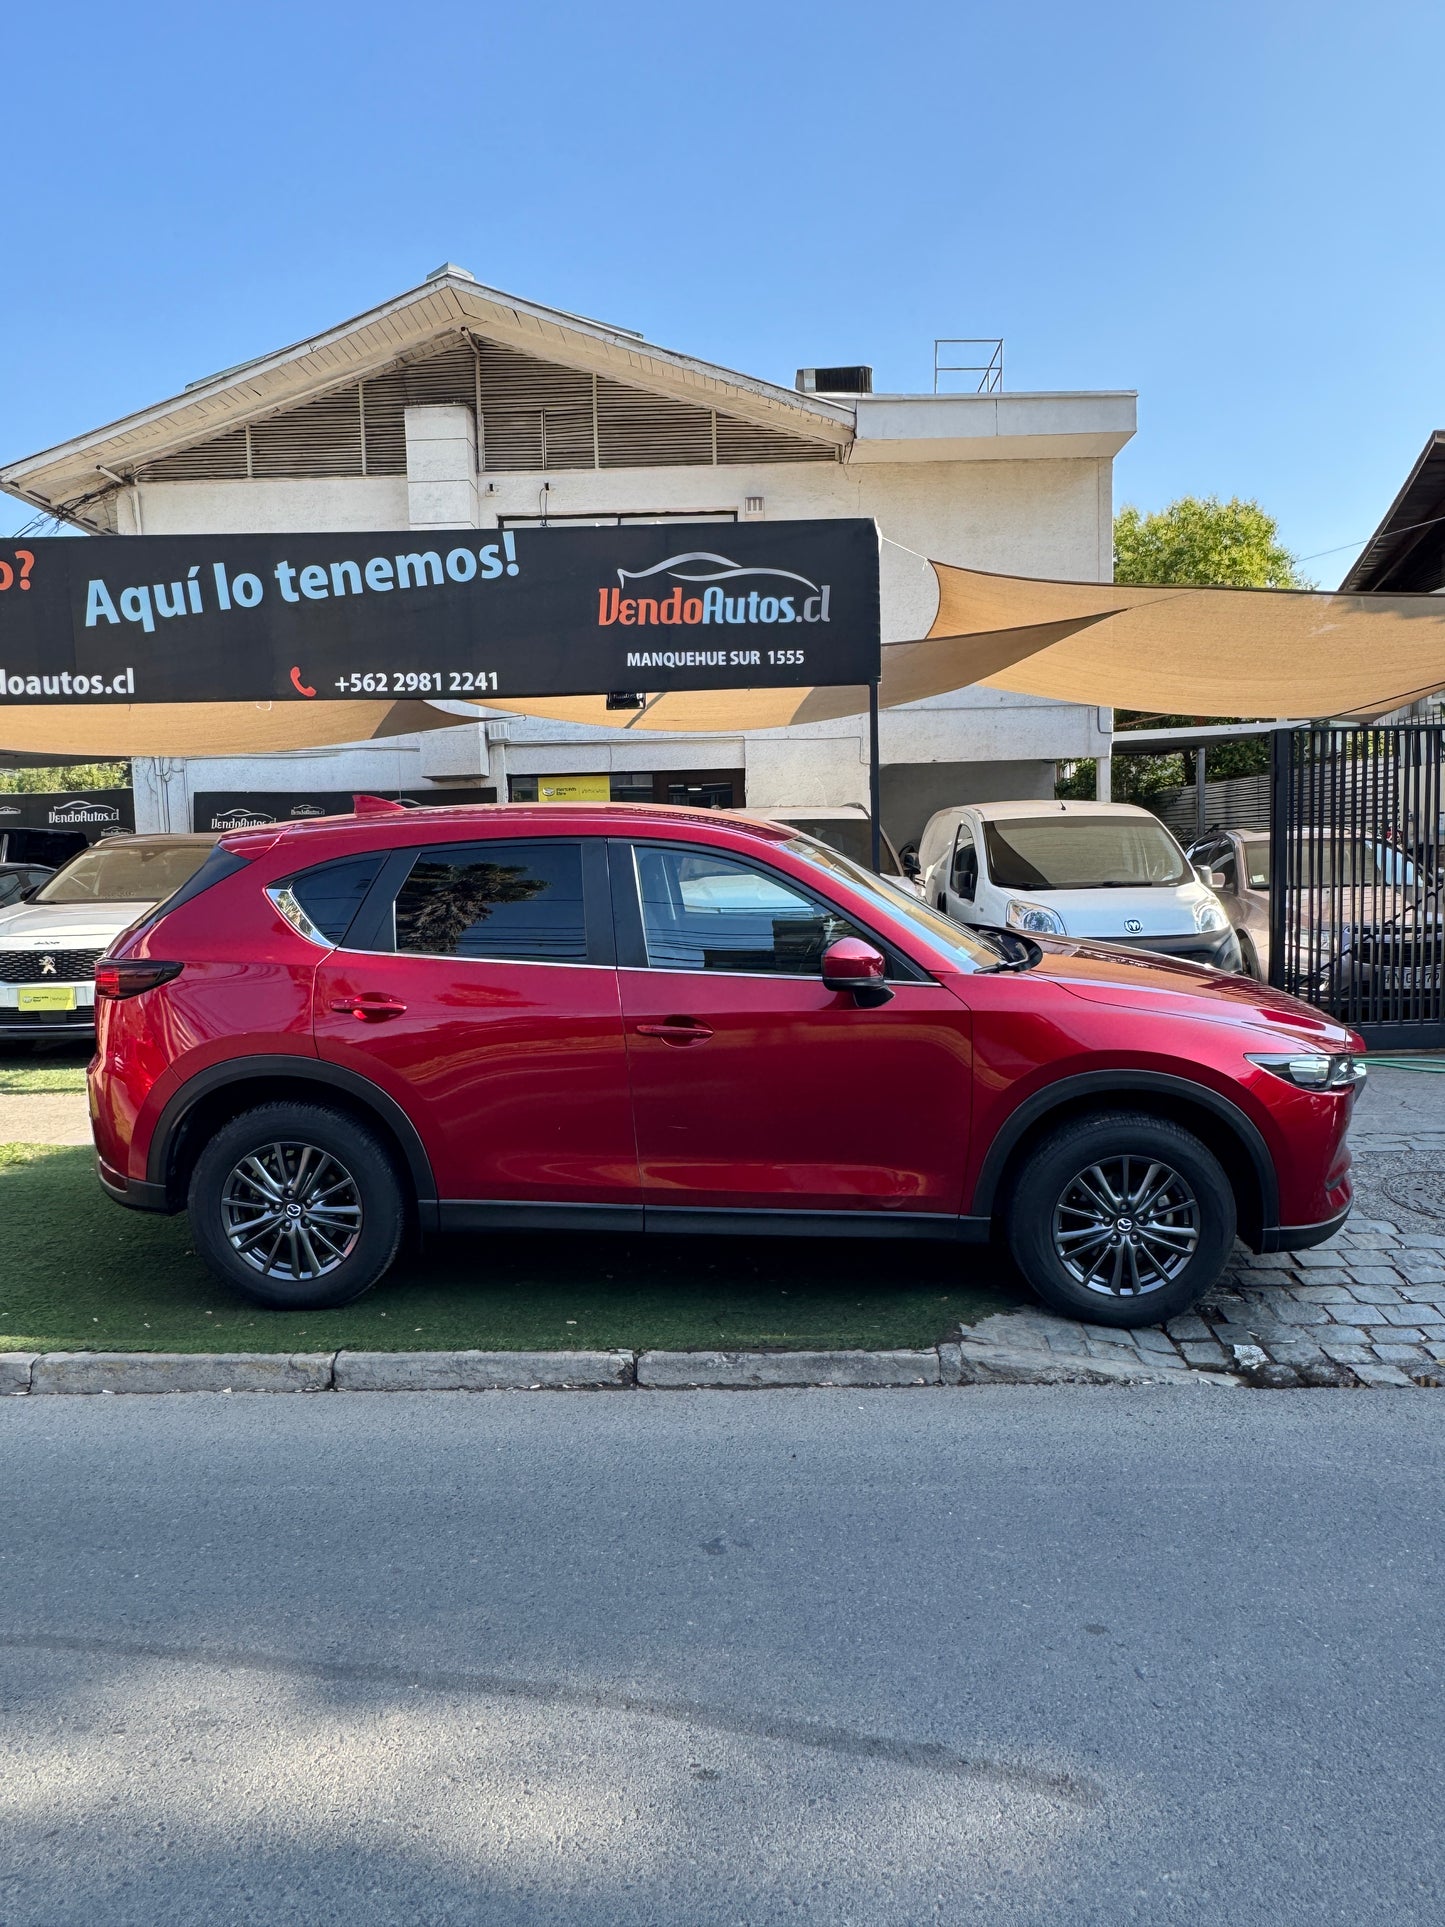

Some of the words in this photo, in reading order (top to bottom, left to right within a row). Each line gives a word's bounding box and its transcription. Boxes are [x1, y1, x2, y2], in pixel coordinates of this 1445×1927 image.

[85, 566, 204, 633] Aquí
[213, 562, 264, 611] lo
[274, 531, 520, 603] tenemos!
[598, 585, 831, 626] VendoAutos.cl
[626, 651, 727, 668] MANQUEHUE
[729, 650, 761, 666] SUR
[767, 650, 805, 665] 1555
[334, 672, 389, 693] +562
[392, 672, 442, 692] 2981
[448, 671, 498, 691] 2241
[48, 808, 120, 824] VendoAutos.cl
